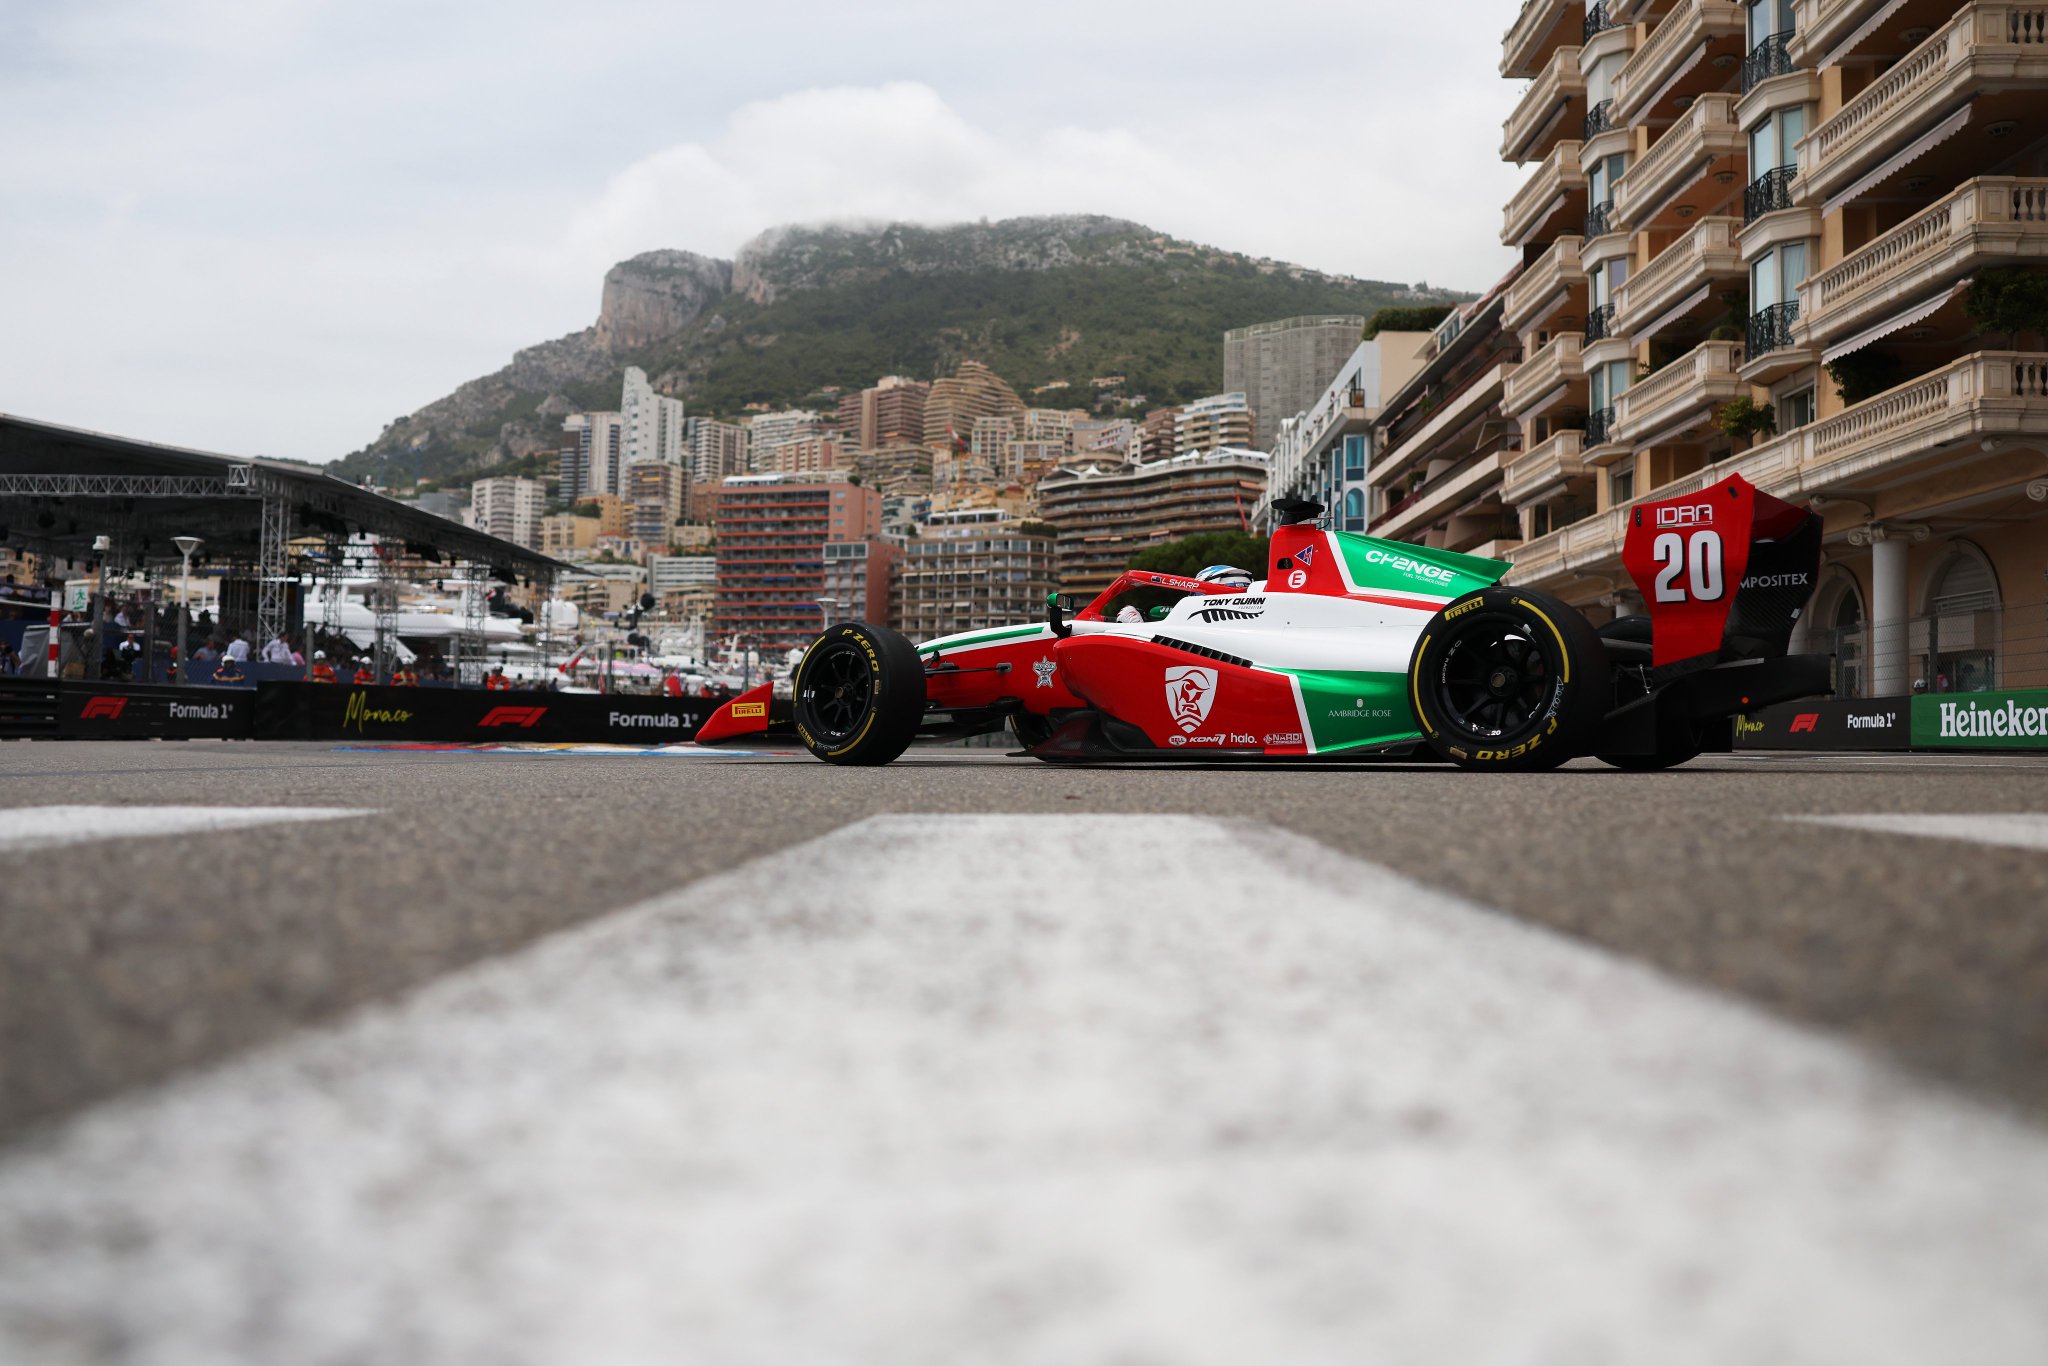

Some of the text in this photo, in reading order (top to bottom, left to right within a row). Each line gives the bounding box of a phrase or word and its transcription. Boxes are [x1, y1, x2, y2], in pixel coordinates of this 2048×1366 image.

[1656, 504, 1713, 525] IDRA
[1653, 530, 1724, 603] 20
[1291, 573, 1303, 586] E
[1203, 597, 1266, 606] TONY QUINN
[1444, 596, 1485, 621] PIRELLI
[841, 628, 853, 636] P
[852, 632, 880, 672] ZERO
[169, 702, 219, 719] Formula
[343, 690, 413, 733] Monaco
[735, 704, 762, 715] PIRELLI
[1328, 709, 1392, 718] AMBRIDGE ROSE
[609, 711, 679, 728] Formula
[1546, 717, 1558, 735] P
[1736, 714, 1765, 741] Monaco
[1847, 713, 1885, 728] Formula
[1273, 733, 1302, 741] NARDI
[1475, 733, 1542, 760] ZERO
